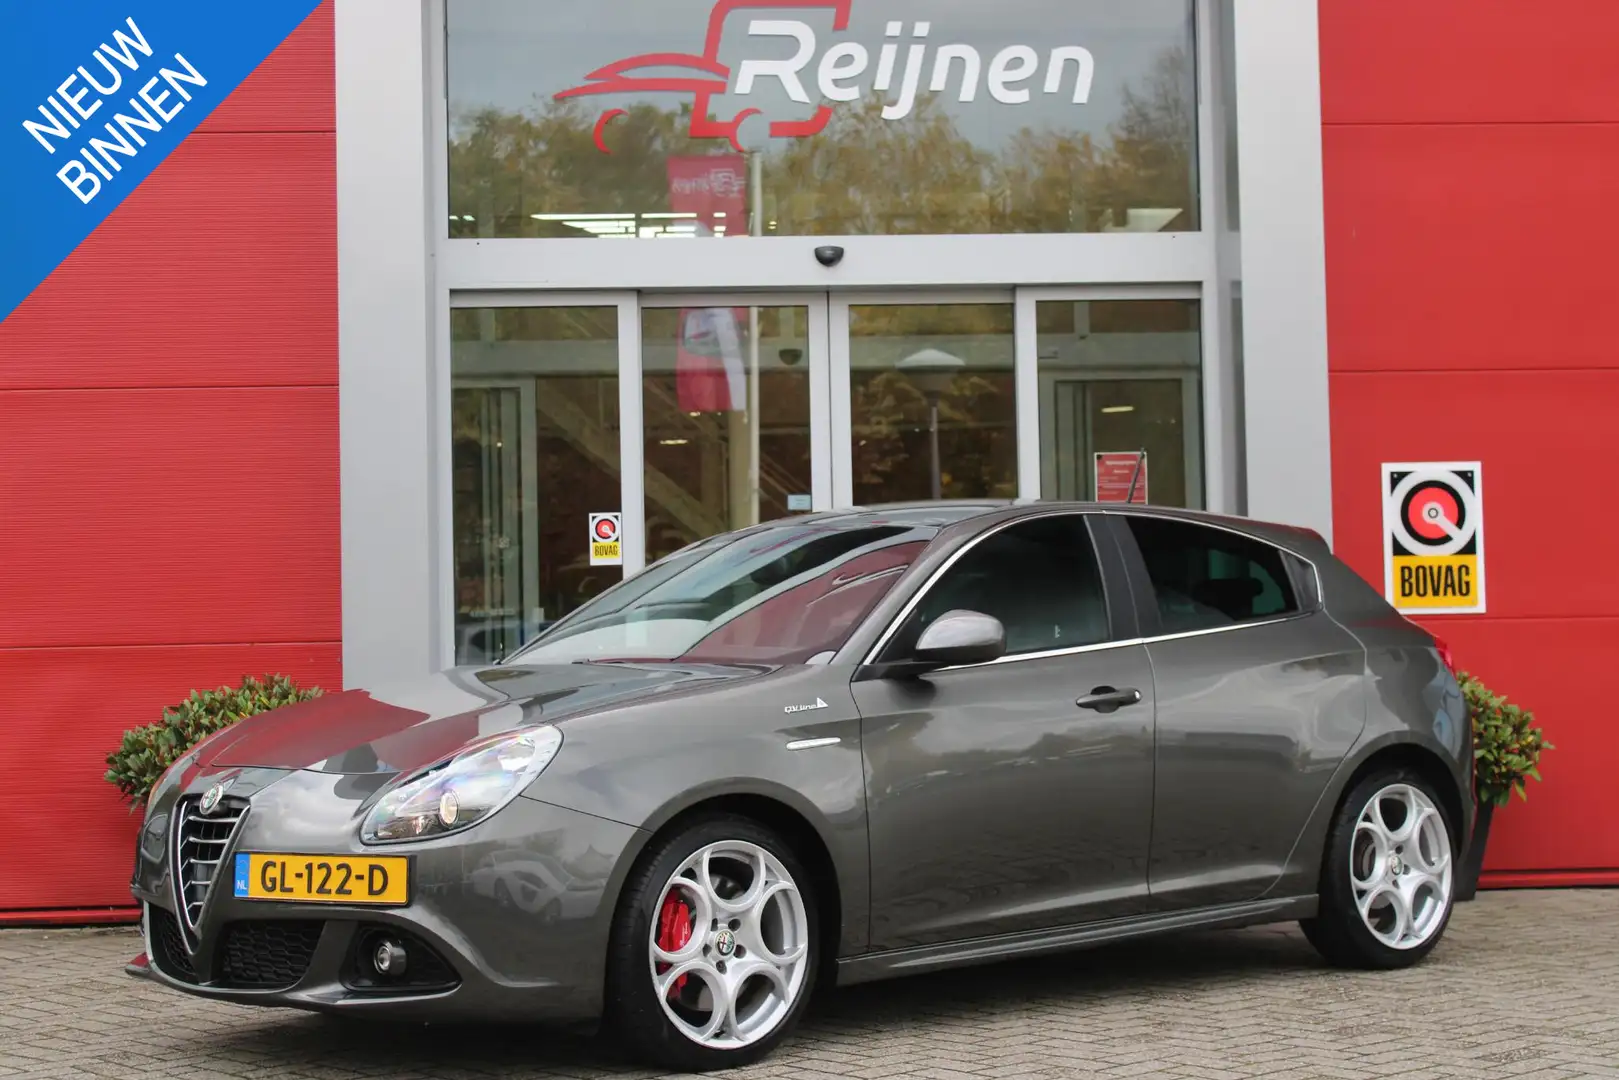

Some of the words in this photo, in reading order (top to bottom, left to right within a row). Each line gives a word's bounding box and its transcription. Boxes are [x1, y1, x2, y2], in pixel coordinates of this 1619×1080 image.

[734, 19, 1095, 121] Reijnen
[594, 544, 619, 556] BOVAG
[1400, 564, 1471, 597] BOVAG
[236, 880, 247, 890] NL
[260, 860, 389, 896] GL-122-D
